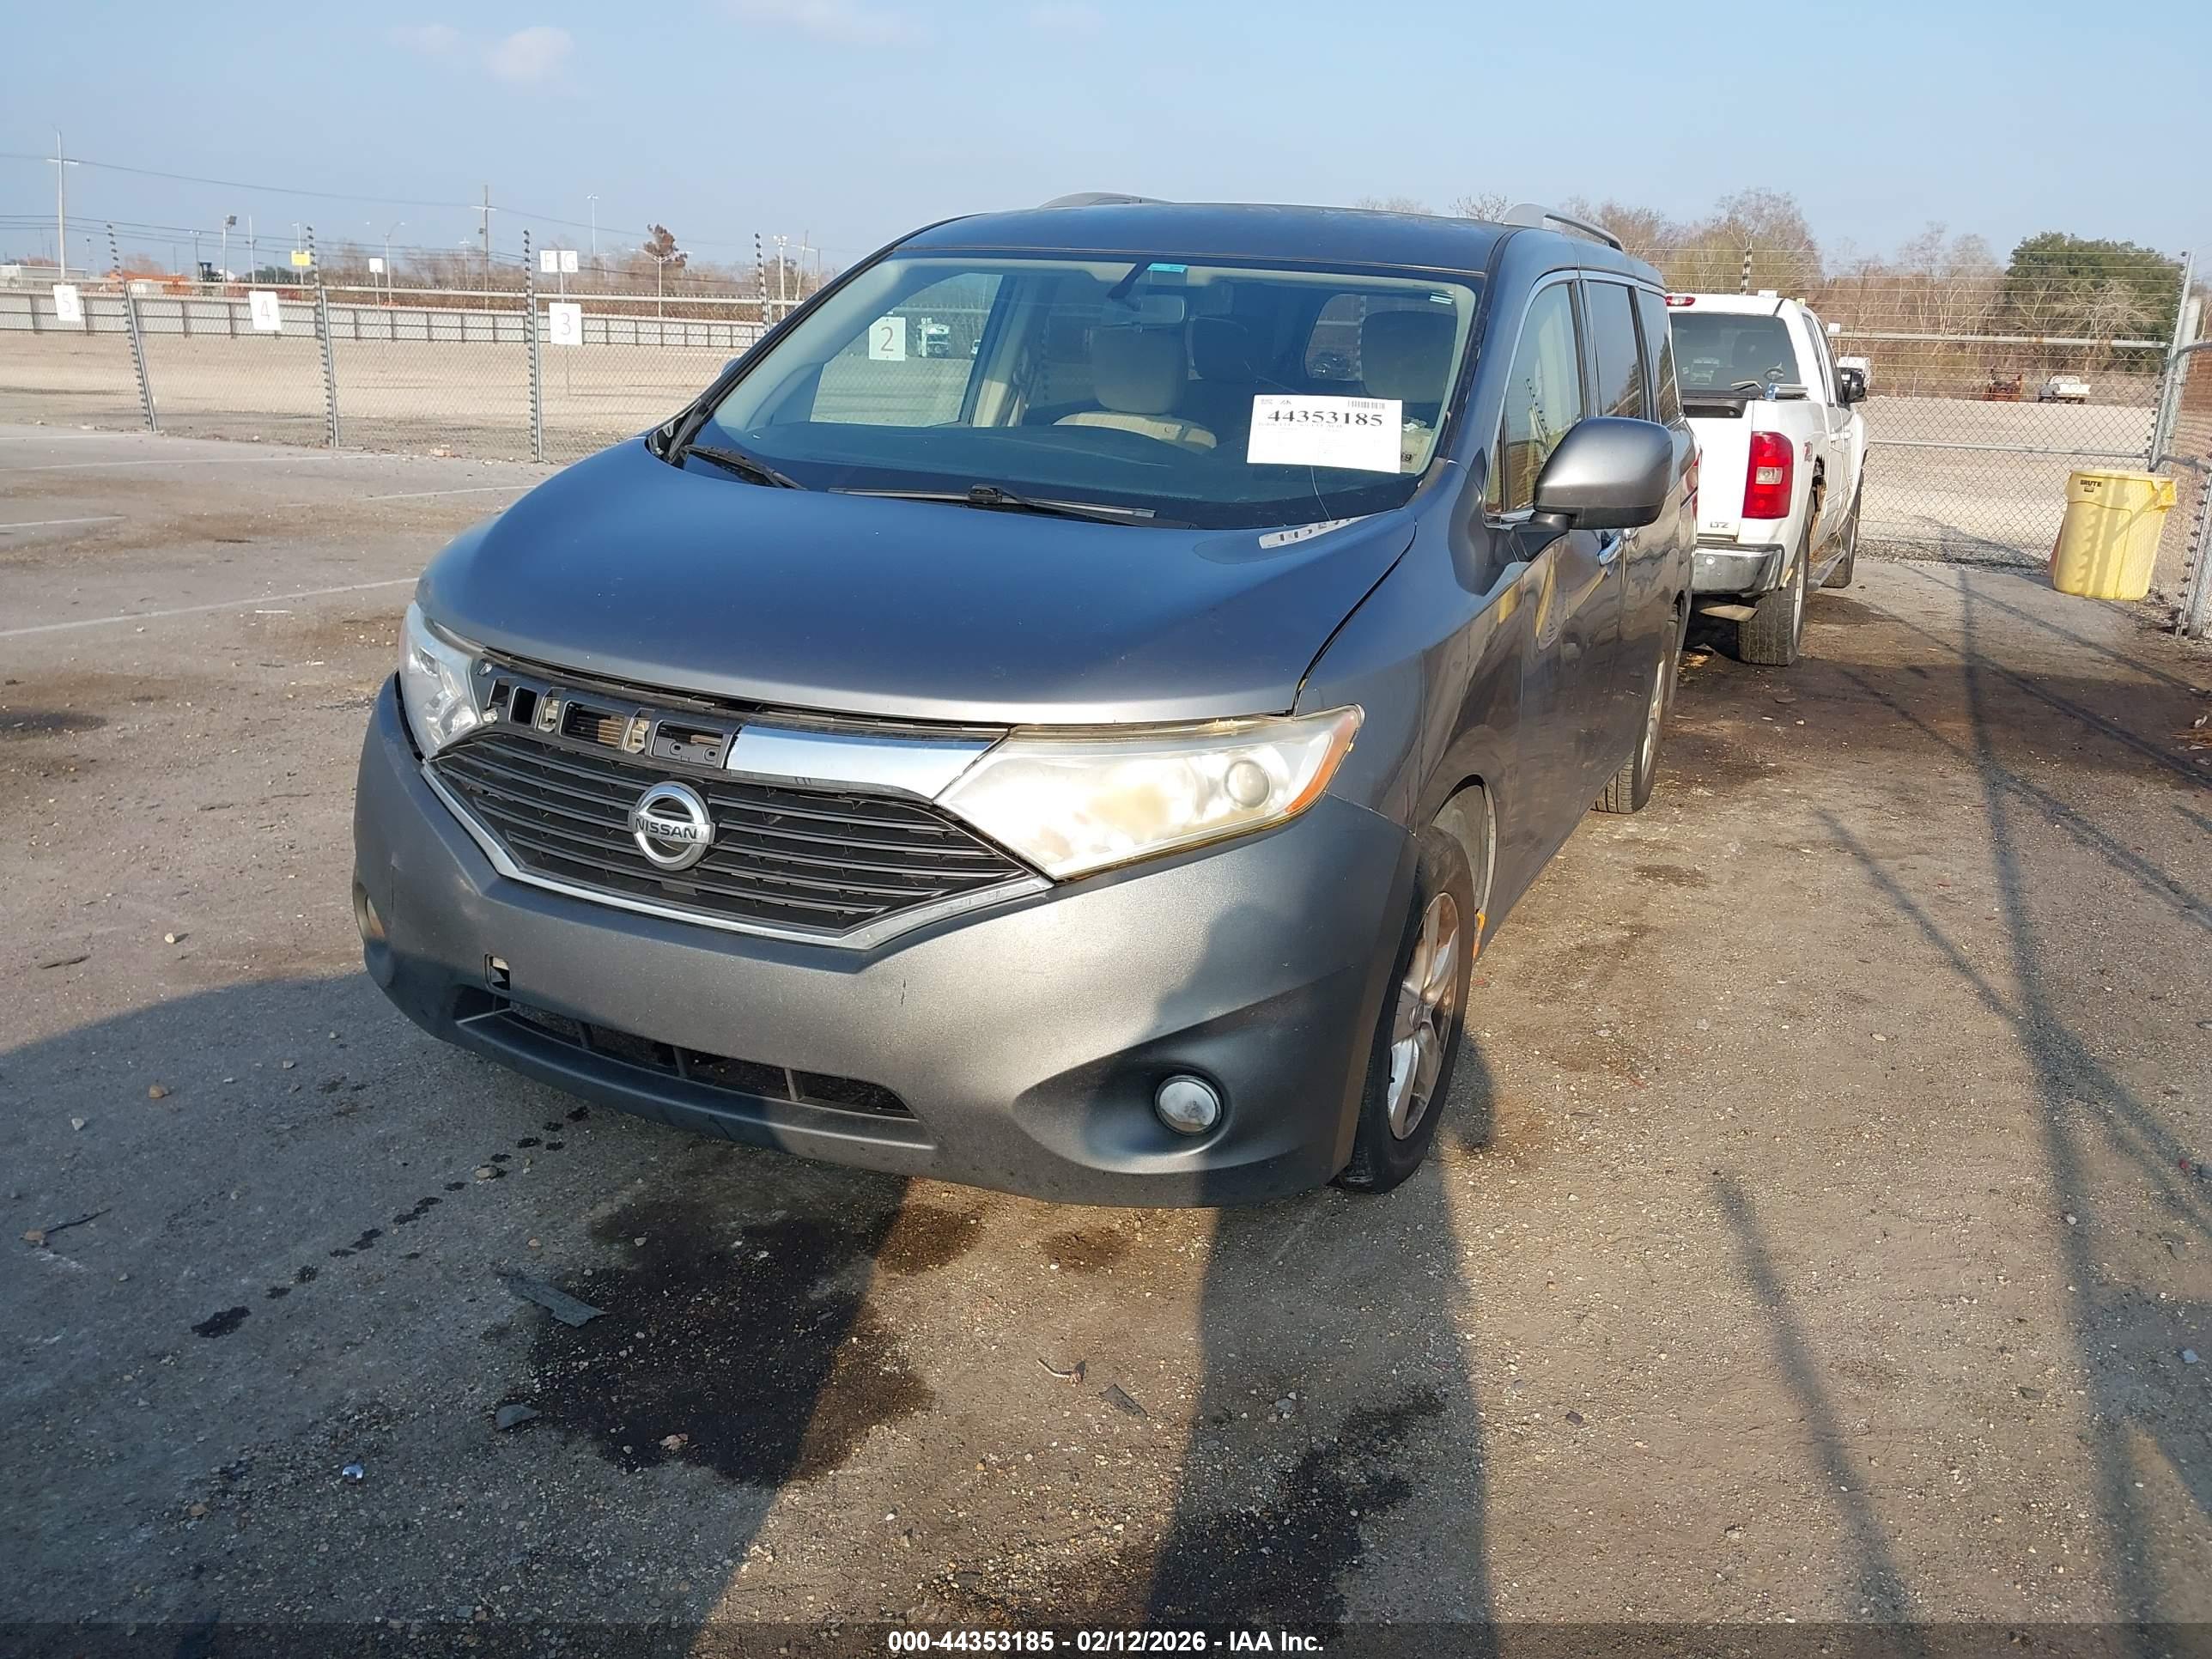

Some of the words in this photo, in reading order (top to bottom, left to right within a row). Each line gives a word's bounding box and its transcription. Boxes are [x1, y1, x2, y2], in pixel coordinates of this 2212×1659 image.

[544, 252, 551, 270] F
[563, 252, 575, 270] G
[61, 292, 72, 313] 5
[260, 300, 270, 321] 4
[559, 312, 571, 336] 3
[880, 326, 894, 352] 2
[1267, 409, 1383, 427] 44353185
[2080, 479, 2103, 488] BRUTE
[1710, 520, 1729, 529] LTZ
[635, 817, 698, 840] NISSAN
